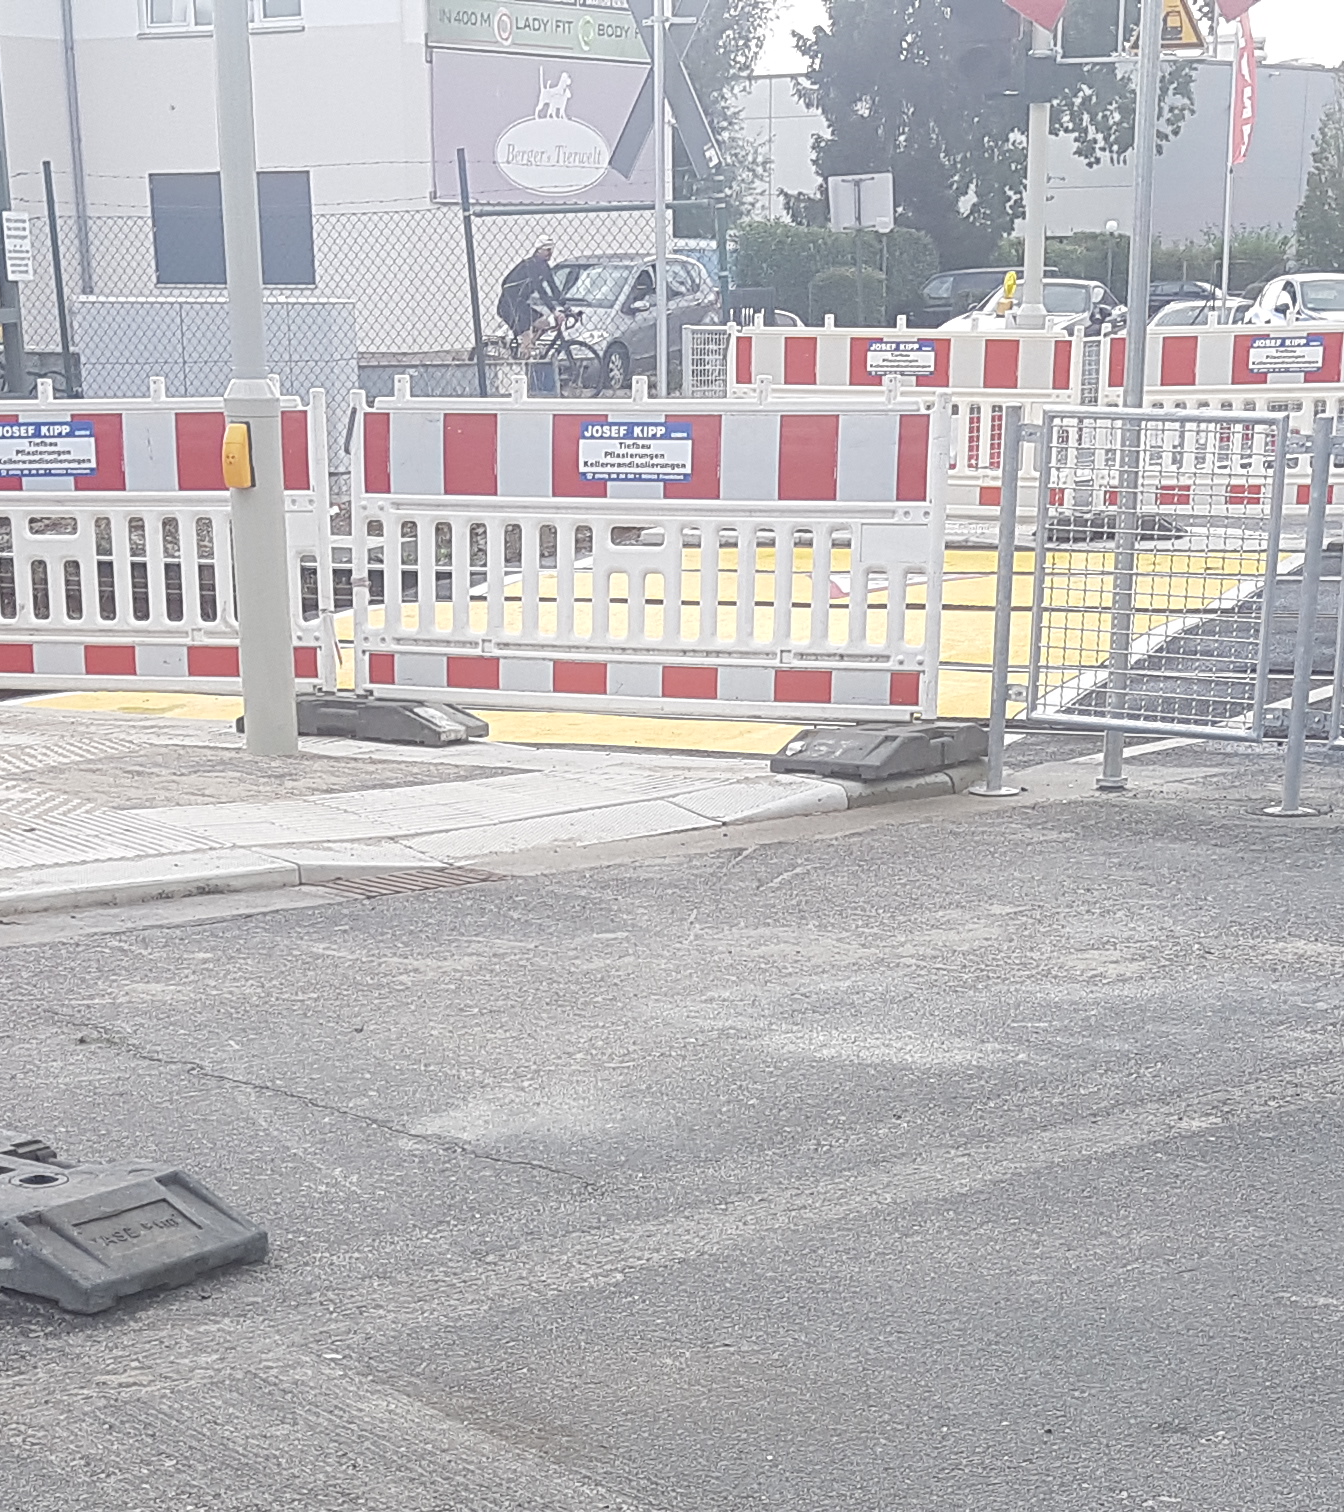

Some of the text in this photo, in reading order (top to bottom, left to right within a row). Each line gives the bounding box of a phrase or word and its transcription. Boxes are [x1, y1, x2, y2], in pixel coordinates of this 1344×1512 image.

[438, 8, 451, 24] IN
[453, 10, 477, 26] 400
[479, 13, 491, 27] M
[515, 16, 551, 33] LADY
[554, 19, 574, 35] FIT
[597, 23, 630, 39] BODY
[555, 144, 602, 166] Tierwelt
[40, 425, 71, 436] KIPP
[583, 425, 628, 438] JOSEF
[633, 425, 666, 438] KIPP
[618, 441, 652, 450] Tiefbau
